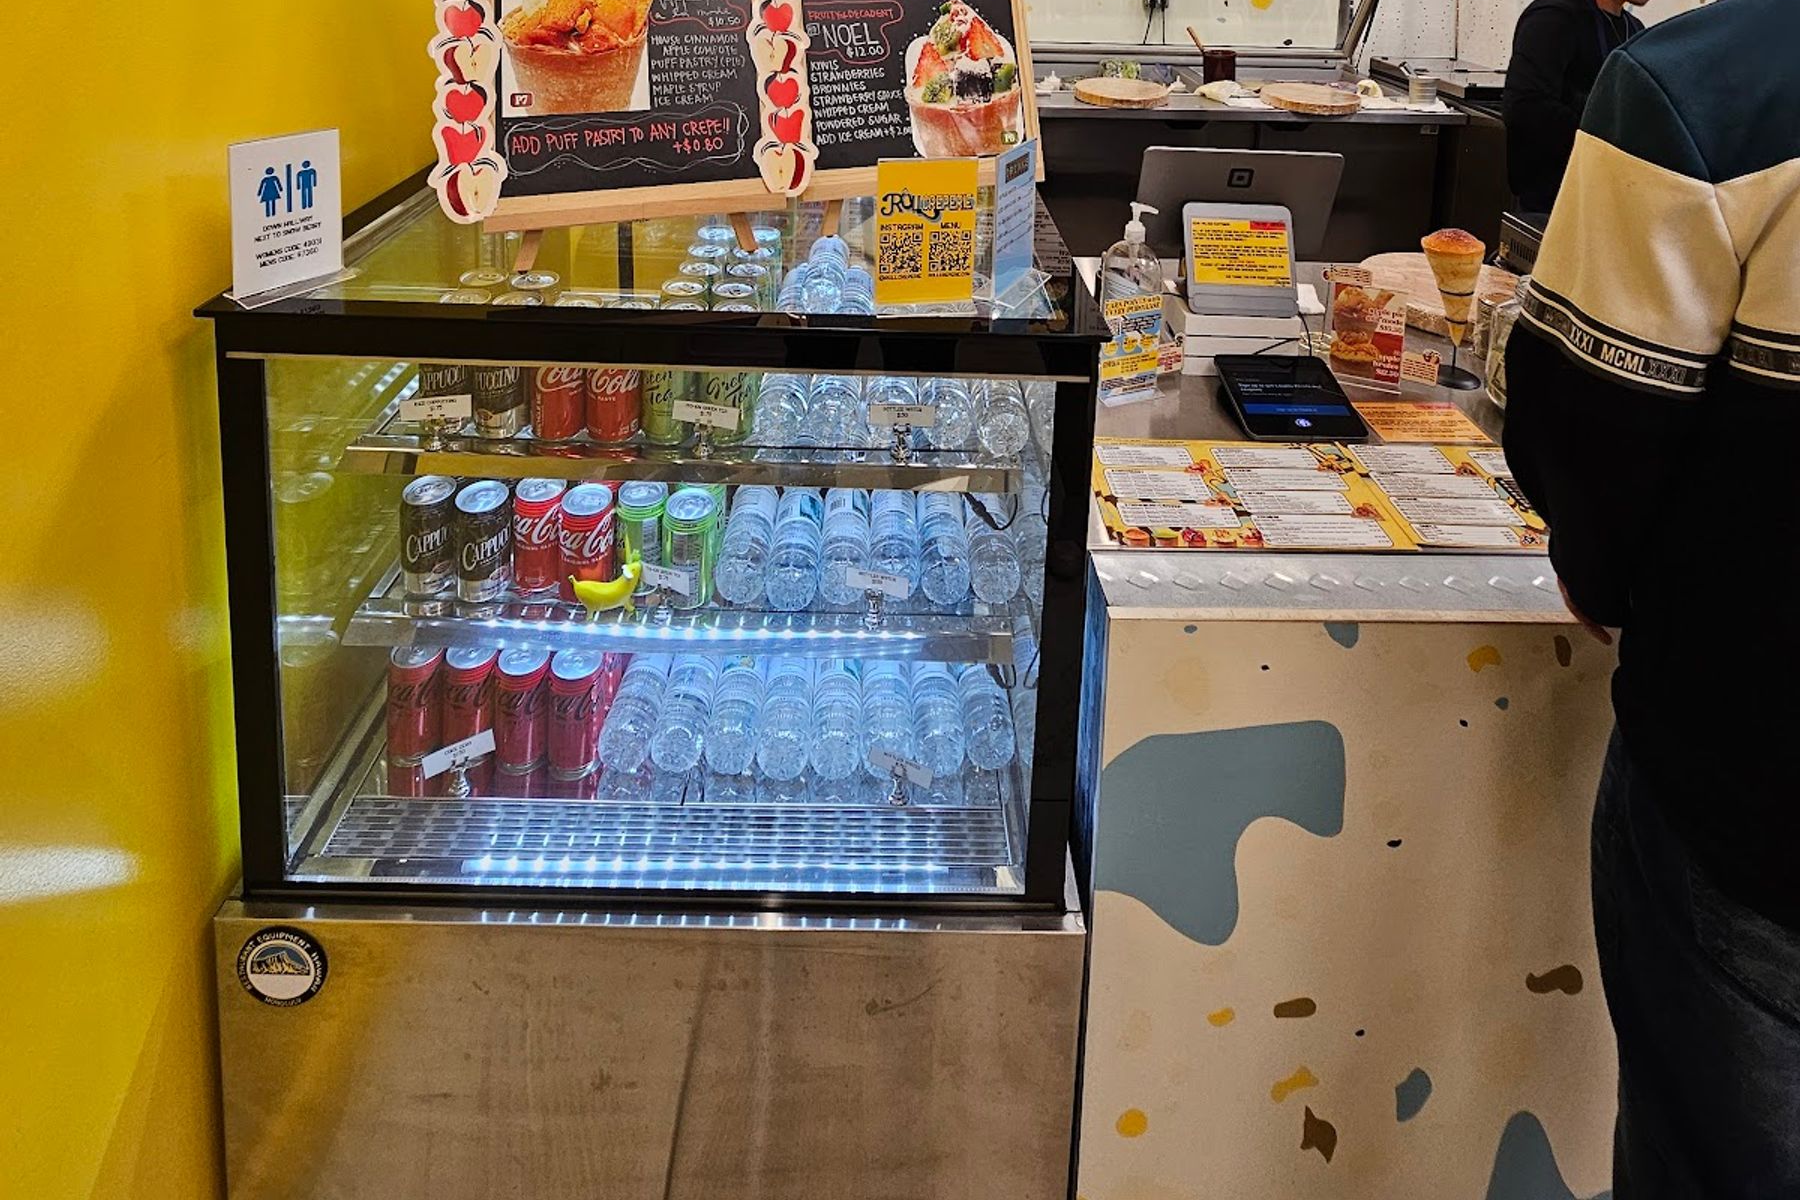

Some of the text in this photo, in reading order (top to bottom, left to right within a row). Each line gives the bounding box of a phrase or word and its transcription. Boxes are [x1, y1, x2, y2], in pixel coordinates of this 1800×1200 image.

[708, 16, 741, 28] $10.50
[650, 34, 738, 46] HOUSE CINNAMON
[822, 22, 880, 48] NOEL
[662, 45, 738, 56] APPLE COMPOTE
[846, 45, 885, 58] $12.00
[650, 54, 746, 70] PUFF PASTRY (PIE)
[810, 60, 840, 72] KIWIS
[651, 68, 738, 82] WHIPPED CREAM
[810, 68, 885, 83] STRAWBERRIES
[652, 82, 722, 96] MAPLE SYRUP
[812, 81, 867, 96] BROWNIES
[514, 94, 528, 106] P7
[654, 94, 714, 108] ICE CREAM
[812, 91, 876, 108] STRAWBERRY
[814, 102, 890, 119] WHIPPED CREAM
[816, 114, 902, 132] POWDERED SUGAR
[511, 117, 731, 156] ADD PUFF PASTRY TO ANY CREPE!!
[816, 134, 836, 146] ADD
[838, 131, 853, 144] ICE
[672, 136, 724, 154] +$0.80
[262, 223, 282, 232] DOWN
[880, 223, 924, 232] INSTAGRAM
[940, 222, 962, 230] MENU
[254, 233, 271, 242] NEXT
[272, 230, 282, 239] TO
[282, 226, 302, 236] SNOW
[256, 931, 312, 950] EQUIPMENT
